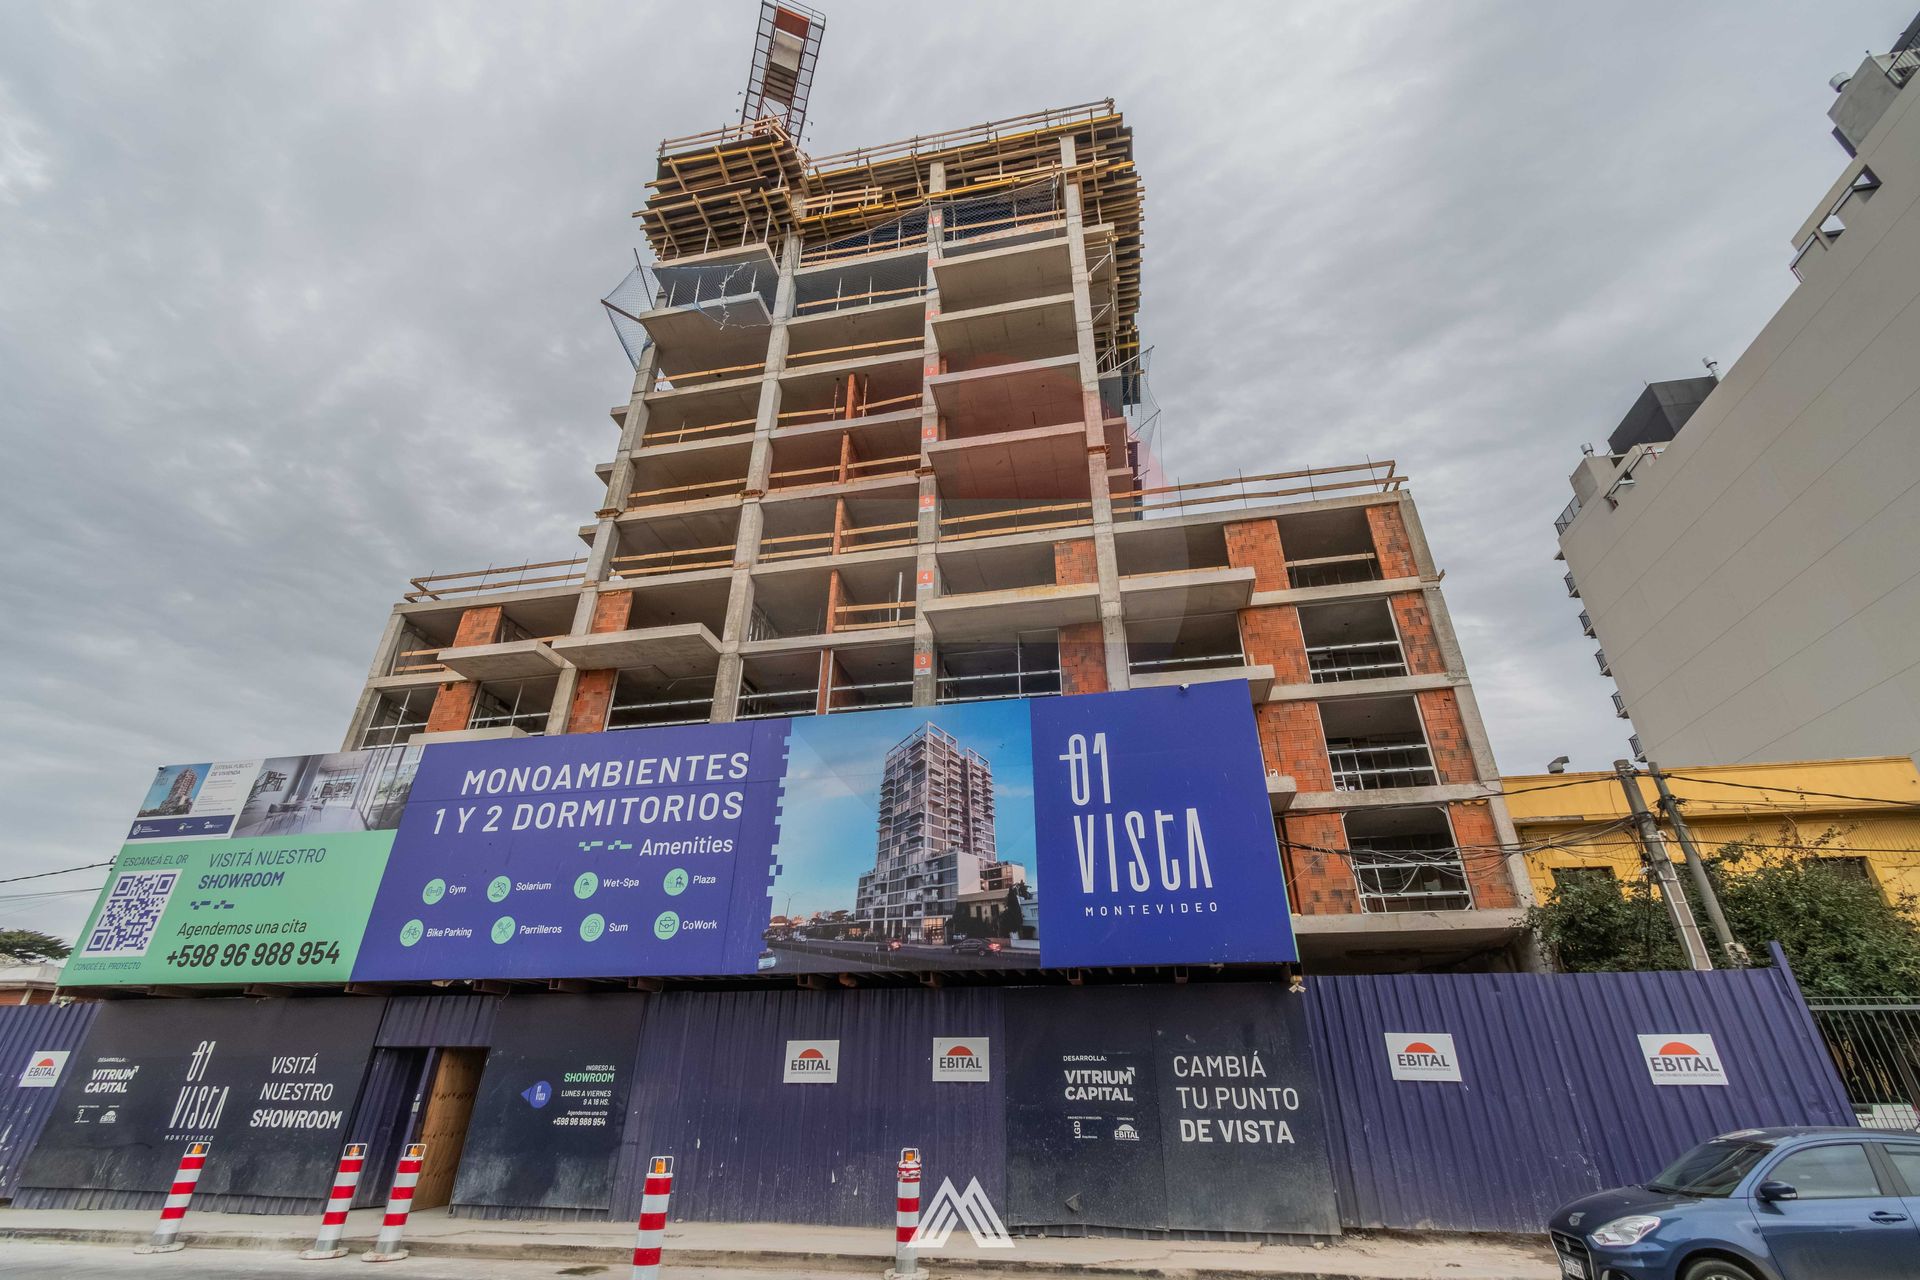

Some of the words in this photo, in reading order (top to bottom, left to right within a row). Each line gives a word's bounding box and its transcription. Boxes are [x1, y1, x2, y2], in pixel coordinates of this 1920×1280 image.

[920, 656, 926, 664] 3
[461, 752, 749, 795] MONOAMBIENTES
[434, 808, 446, 834] 1
[458, 807, 476, 833] Y
[482, 805, 502, 832] 2
[512, 791, 744, 831] DORMITORIOS
[640, 835, 733, 856] Amenities
[1073, 807, 1213, 894] VISTA
[163, 855, 173, 865] EL
[209, 848, 255, 868] VISITÁ
[255, 847, 327, 866] NUESTRO
[198, 871, 285, 890] SHOWROOM
[515, 880, 552, 892] Solarium
[603, 877, 640, 890] Wet-Spa
[693, 874, 717, 885] Plaza
[449, 884, 467, 896] Gym
[1085, 901, 1218, 917] MONTEVIDEO
[177, 921, 253, 939] Agendemos
[255, 924, 279, 935] una
[281, 920, 307, 934] cita
[519, 923, 562, 935] Parrilleros
[608, 922, 628, 932] Sum
[682, 919, 718, 931] CoWork
[426, 926, 445, 938] Bike
[444, 926, 472, 939] Parking
[166, 943, 218, 969] +598
[220, 943, 249, 967] 96
[251, 942, 294, 966] 988
[296, 941, 340, 964] 954
[270, 1052, 319, 1074] VISITÁ
[791, 1059, 831, 1071] EBITAL
[939, 1057, 982, 1069] EBITAL
[1173, 1050, 1267, 1078] CAMBIÁ
[1397, 1054, 1450, 1067] EBITAL
[1649, 1056, 1720, 1072] EBITAL
[28, 1067, 56, 1077] EBITAL
[92, 1068, 136, 1080] VITRIUM
[564, 1072, 615, 1083] SHOWROOM
[1064, 1069, 1133, 1085] VITRIUM
[84, 1081, 128, 1093] CAPITAL
[259, 1082, 334, 1102] NUESTRO
[1064, 1086, 1134, 1102] CAPITAL
[1175, 1086, 1207, 1110] TU
[1215, 1087, 1300, 1111] PUNTO
[249, 1108, 343, 1130] SHOWROOM
[1073, 1120, 1081, 1139] LGD
[1114, 1130, 1140, 1139] EBITAL
[1179, 1119, 1213, 1143] DE
[1217, 1119, 1295, 1144] VISTA
[164, 1134, 215, 1142] MONTEVIDEO
